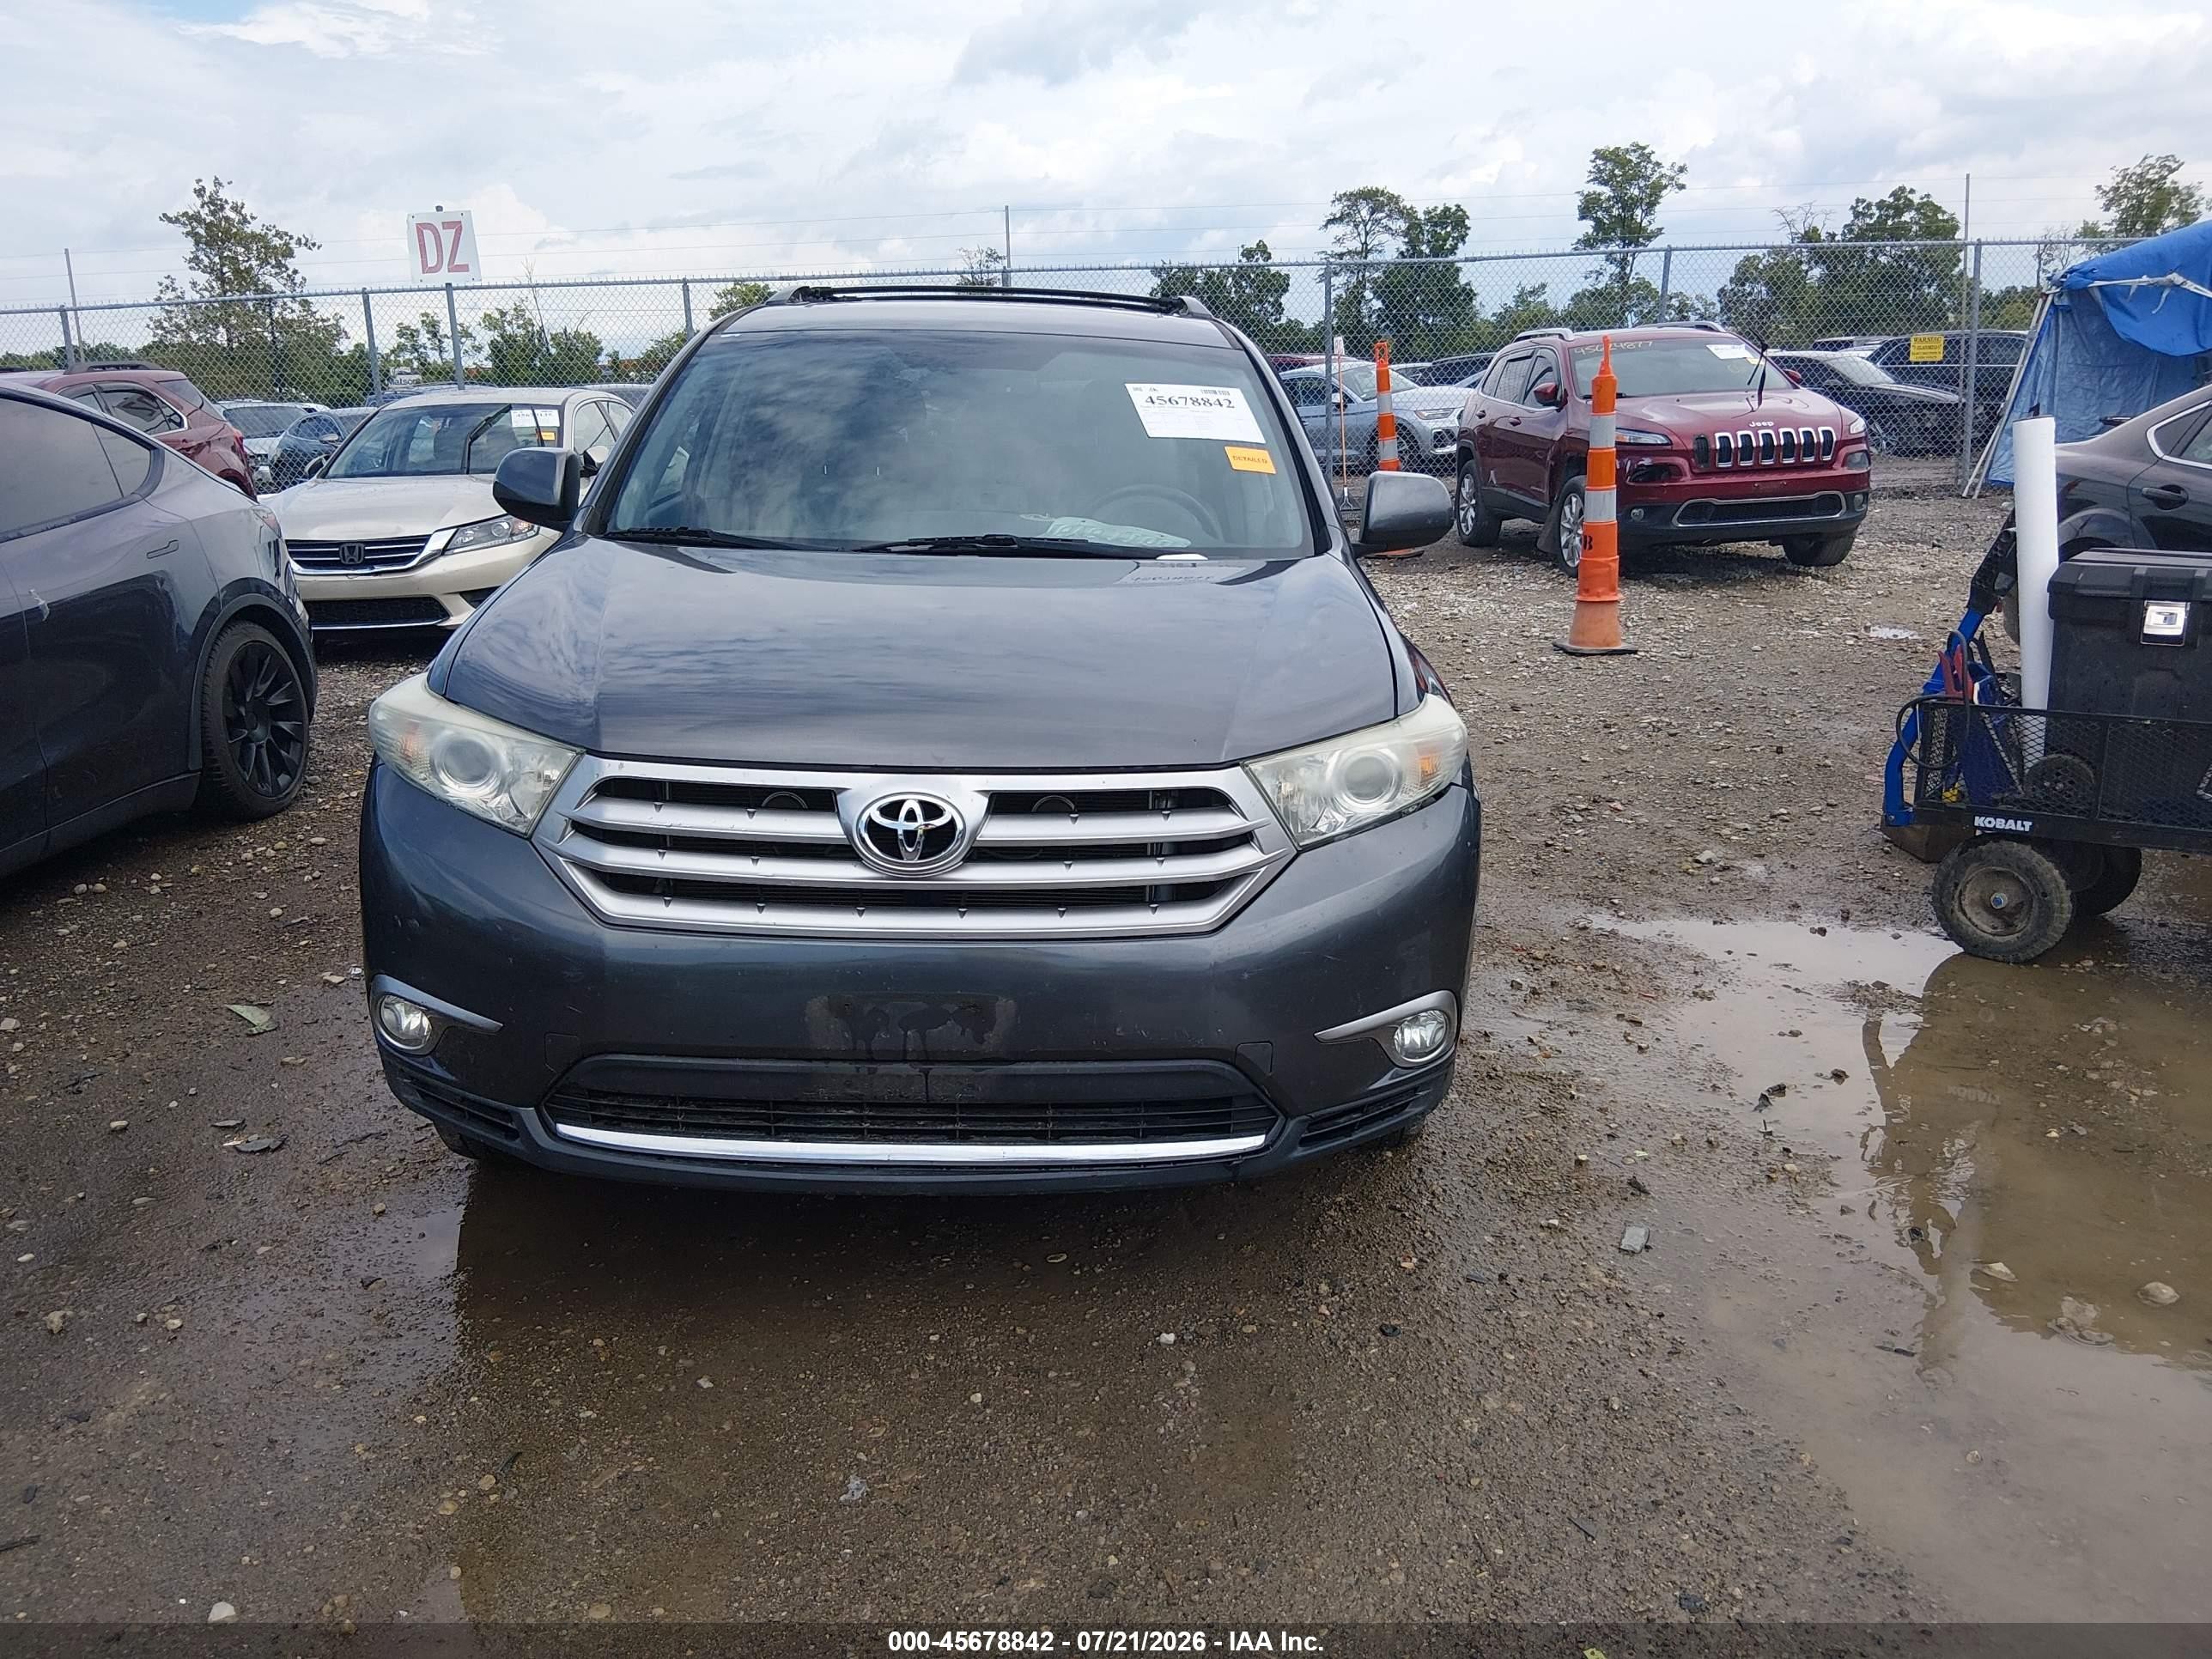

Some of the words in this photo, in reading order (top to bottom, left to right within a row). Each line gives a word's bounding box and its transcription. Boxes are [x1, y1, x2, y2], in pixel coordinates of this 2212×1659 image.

[415, 220, 470, 274] DZ
[1145, 395, 1235, 409] 45678842
[1974, 816, 2033, 832] KOBALT
